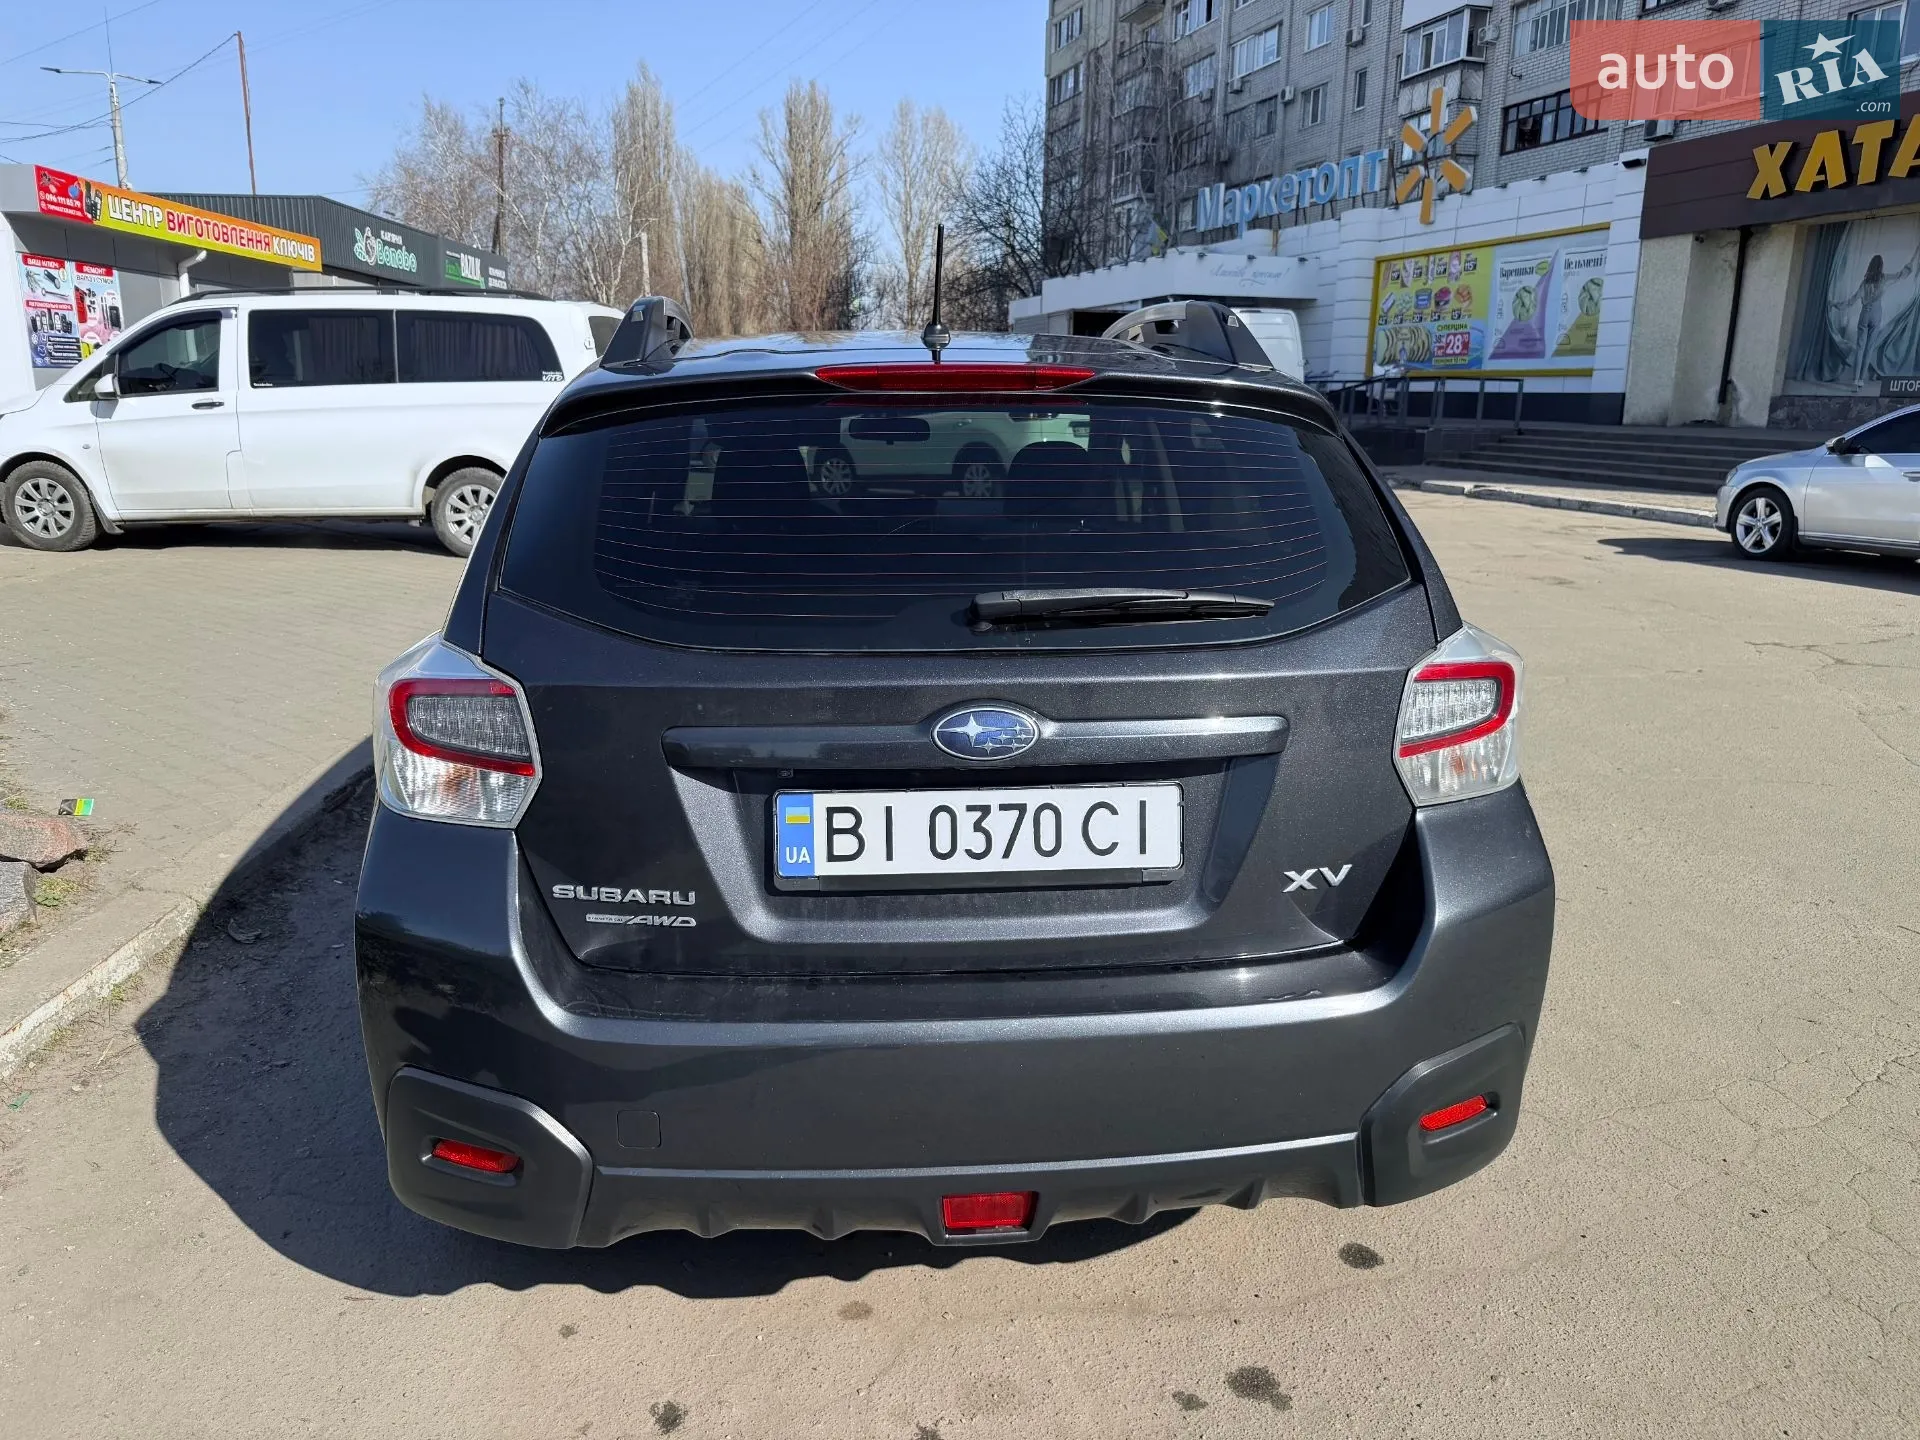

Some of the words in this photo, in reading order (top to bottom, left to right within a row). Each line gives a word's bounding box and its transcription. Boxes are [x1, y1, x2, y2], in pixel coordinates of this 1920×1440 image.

[1196, 149, 1390, 239] Маркетопт
[107, 194, 163, 228] ЦЕНТР
[166, 209, 271, 253] ВИГОТОВЛЕННЯ
[272, 236, 315, 262] КЛЮЧІВ
[376, 238, 417, 272] Bonobo
[826, 806, 893, 862] BI
[928, 802, 1062, 861] 0370
[1081, 800, 1147, 856] CI
[786, 847, 811, 863] UA
[1282, 864, 1353, 893] XV
[552, 884, 696, 906] SUBARU
[626, 915, 697, 928] AWD
